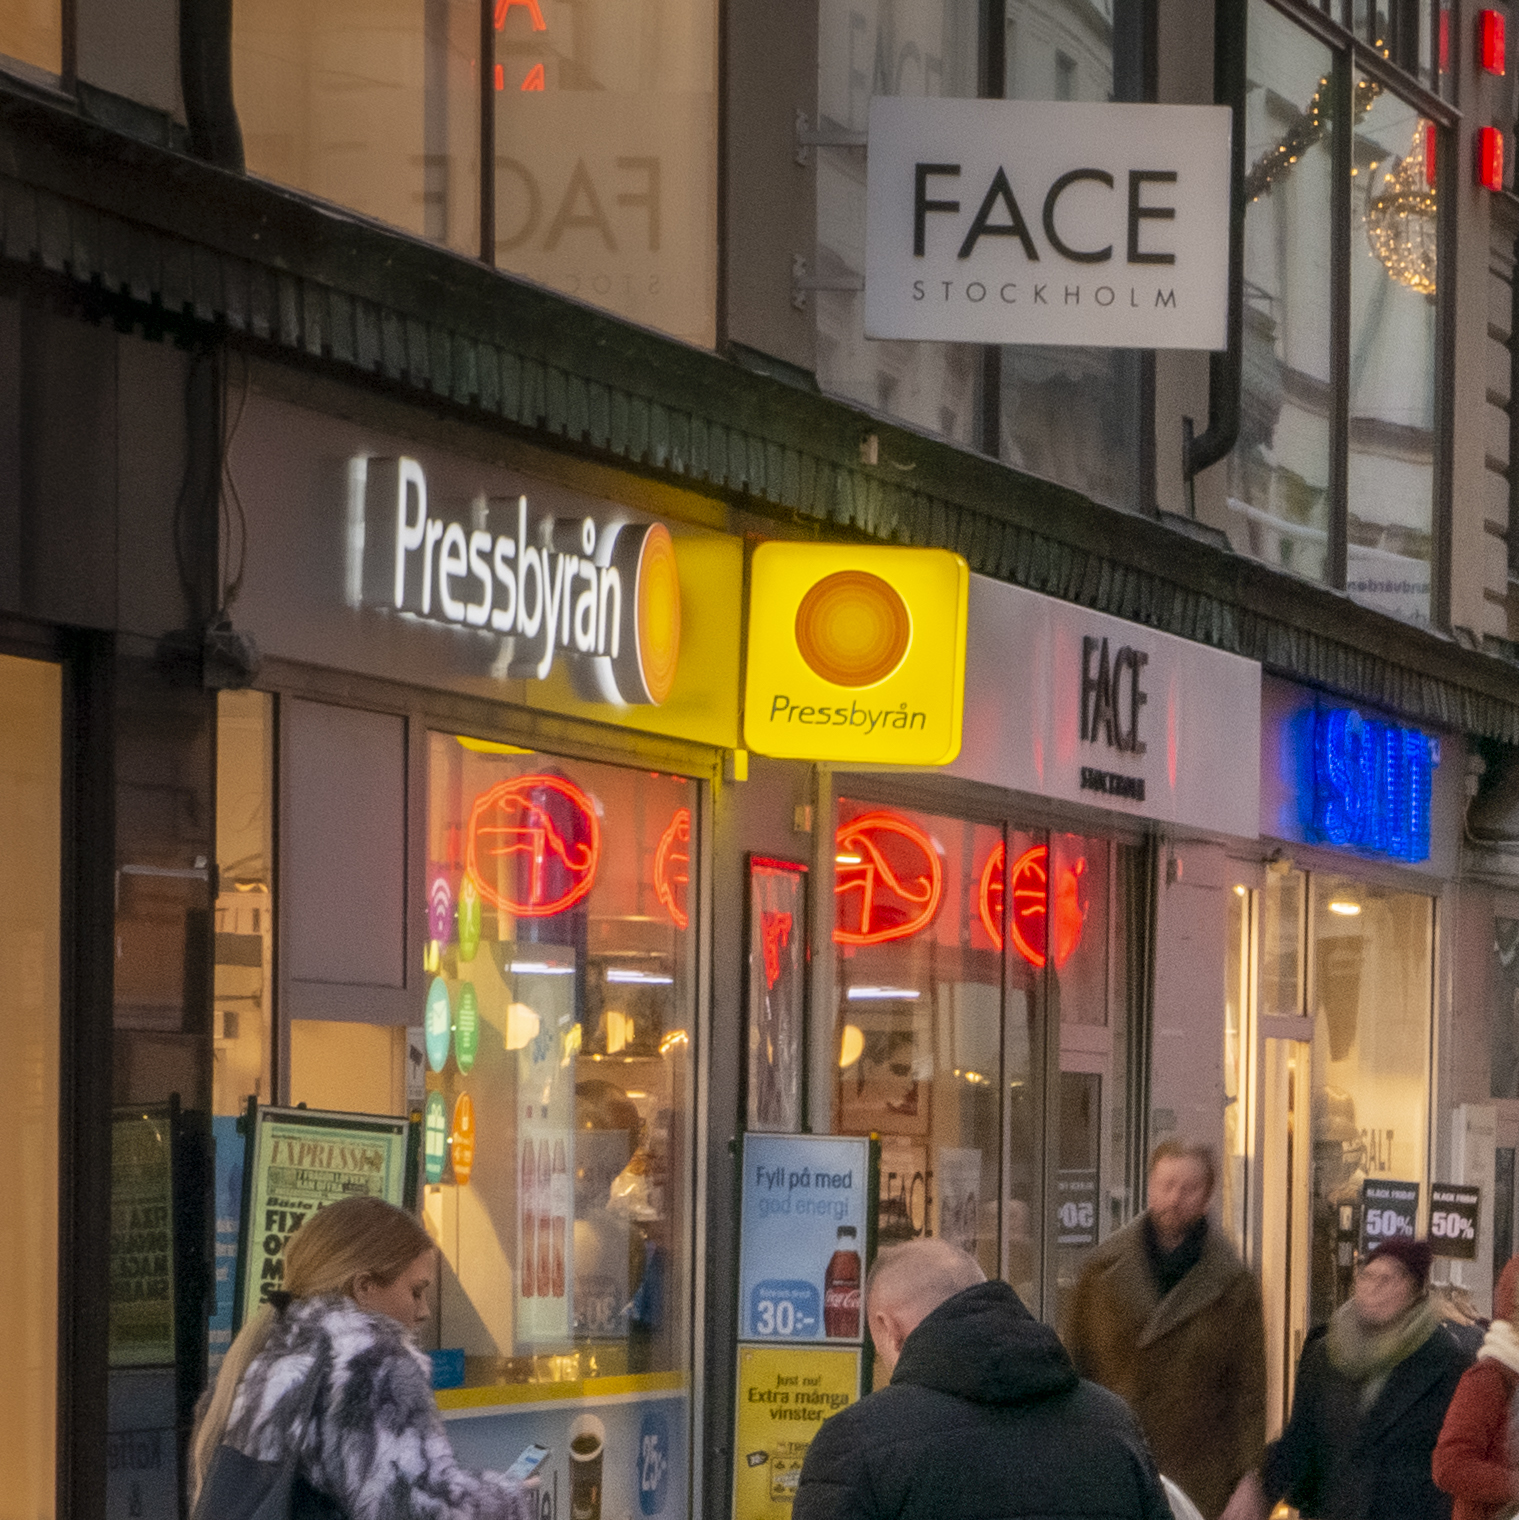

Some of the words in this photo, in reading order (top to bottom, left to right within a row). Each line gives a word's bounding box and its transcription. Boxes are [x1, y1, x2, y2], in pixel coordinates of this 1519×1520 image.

[911, 162, 1179, 265] FACE
[911, 280, 1178, 309] STOCKHOLM
[396, 456, 621, 681] Pressbyrån
[1080, 635, 1149, 755] FACE
[770, 694, 927, 734] Pressbyrån
[756, 1166, 785, 1190] Fyll
[788, 1167, 811, 1193] på
[815, 1170, 853, 1189] med
[265, 1209, 306, 1233] FIX
[1366, 1208, 1413, 1237] 50%
[1431, 1211, 1475, 1240] 50%
[756, 1300, 815, 1336] 30:-
[748, 1388, 790, 1404] Extra
